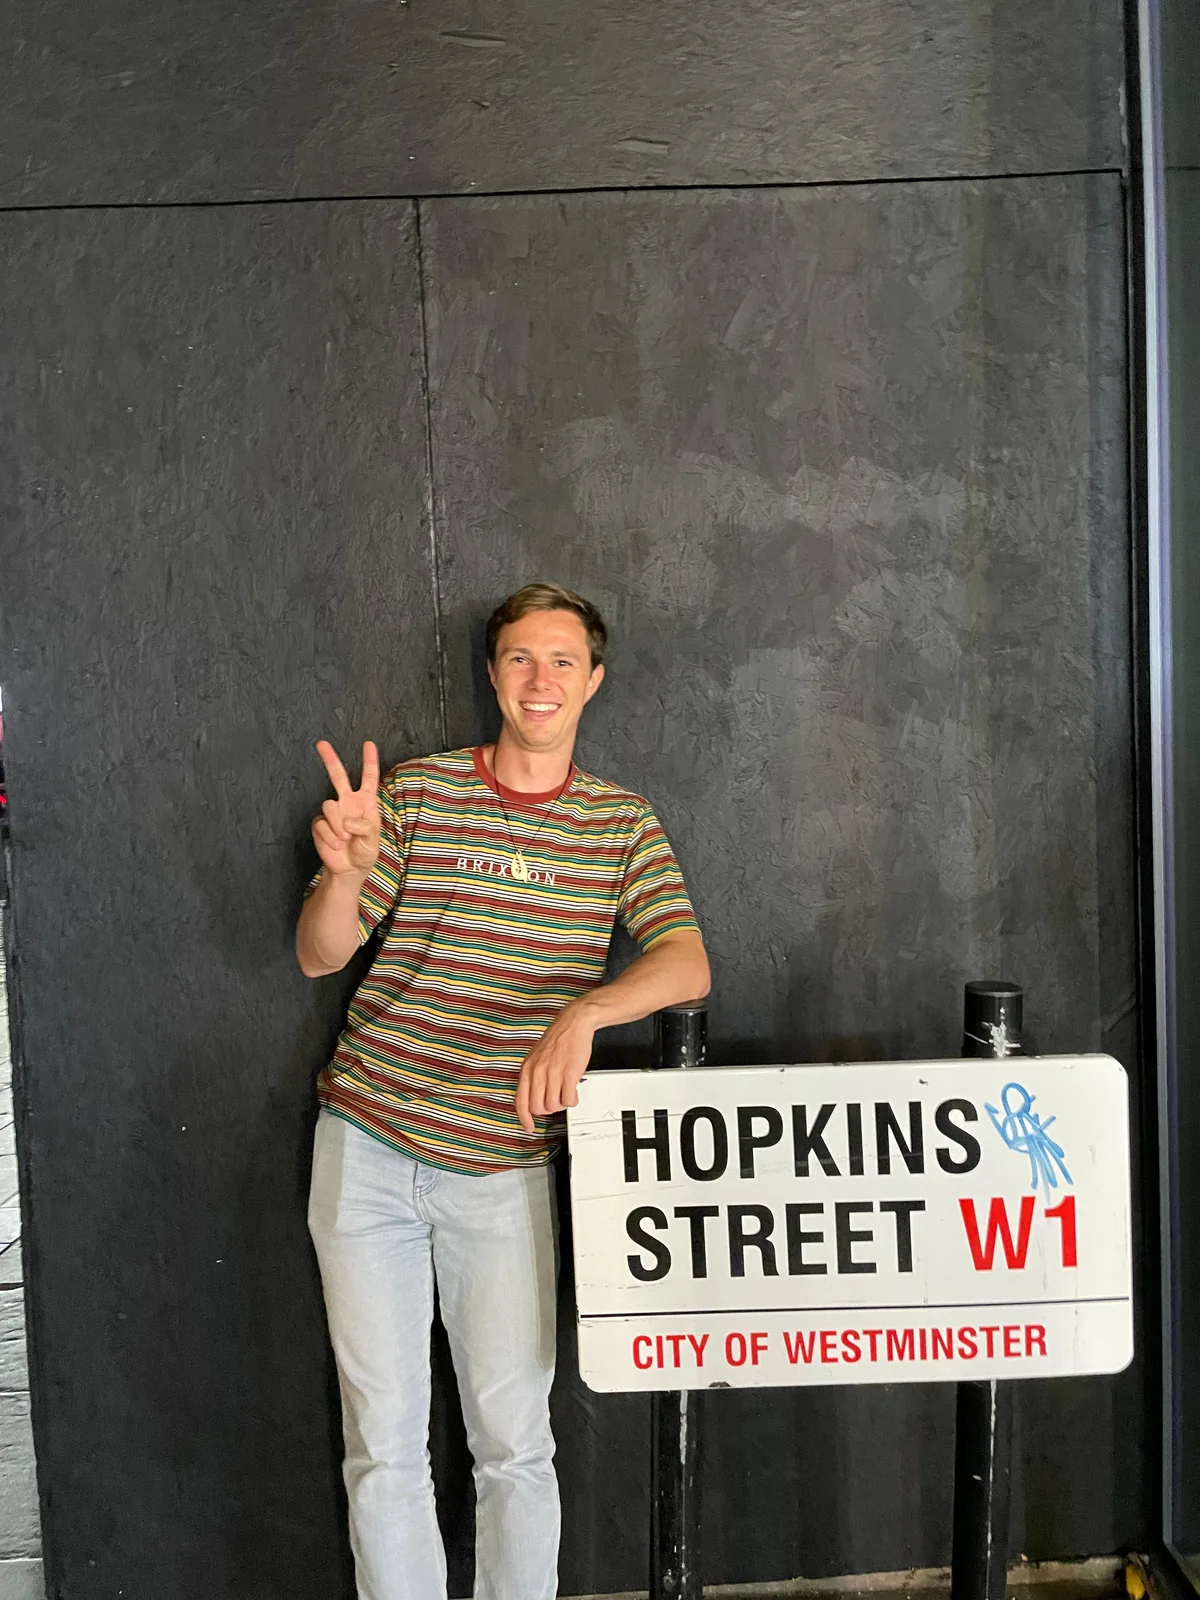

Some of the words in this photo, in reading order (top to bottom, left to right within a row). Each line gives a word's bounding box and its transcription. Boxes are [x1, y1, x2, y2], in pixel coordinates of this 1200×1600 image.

[456, 857, 556, 886] BRIXON
[620, 1098, 982, 1183] HOPKINS
[625, 1200, 926, 1282] STREET
[958, 1194, 1078, 1272] W1
[632, 1333, 710, 1370] CITY
[724, 1331, 769, 1367] OF
[782, 1324, 1048, 1365] WESTMINSTER
